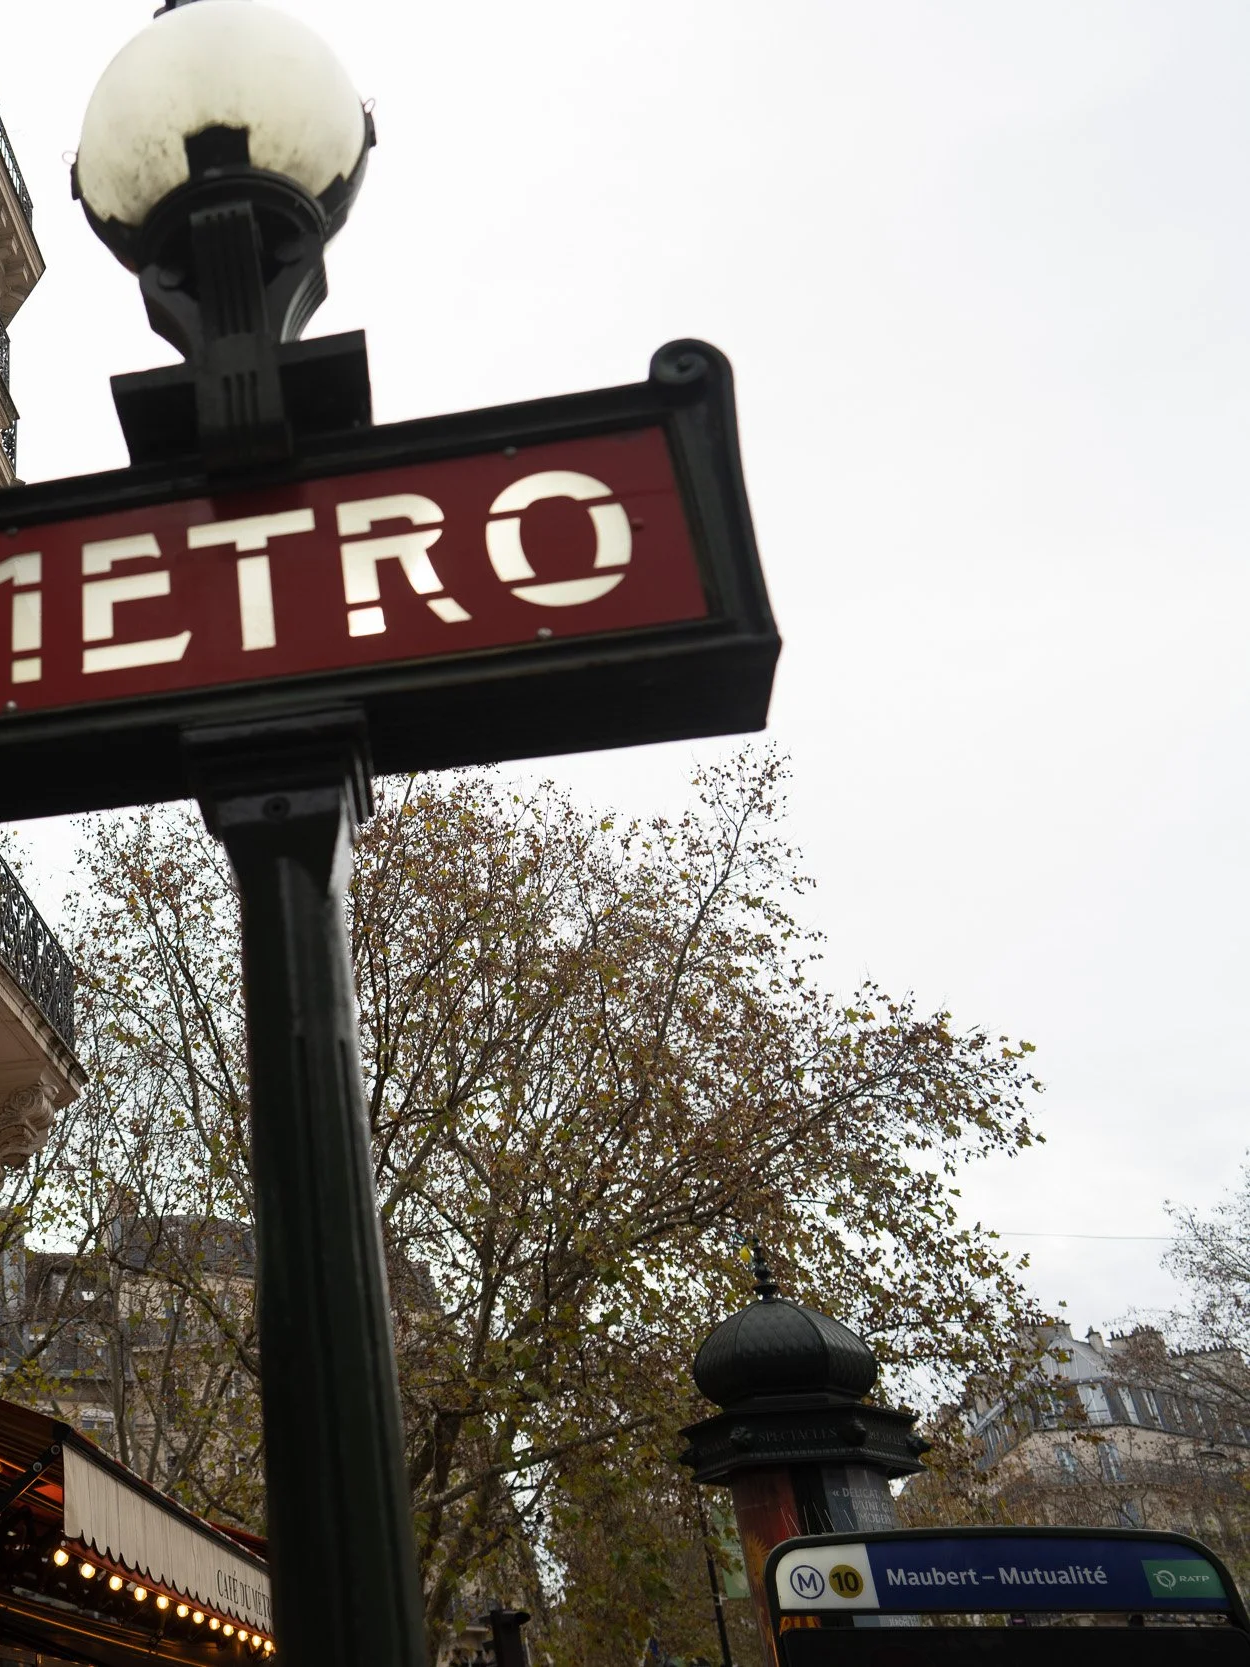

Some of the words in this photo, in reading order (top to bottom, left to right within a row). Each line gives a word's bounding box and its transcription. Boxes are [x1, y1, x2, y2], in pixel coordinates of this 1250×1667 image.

[832, 1570, 859, 1594] 10
[887, 1566, 979, 1586] Maubert
[999, 1564, 1108, 1586] Mutualité
[1179, 1575, 1210, 1584] RATP
[217, 1569, 239, 1605] CAFÉ
[239, 1581, 251, 1610] DU
